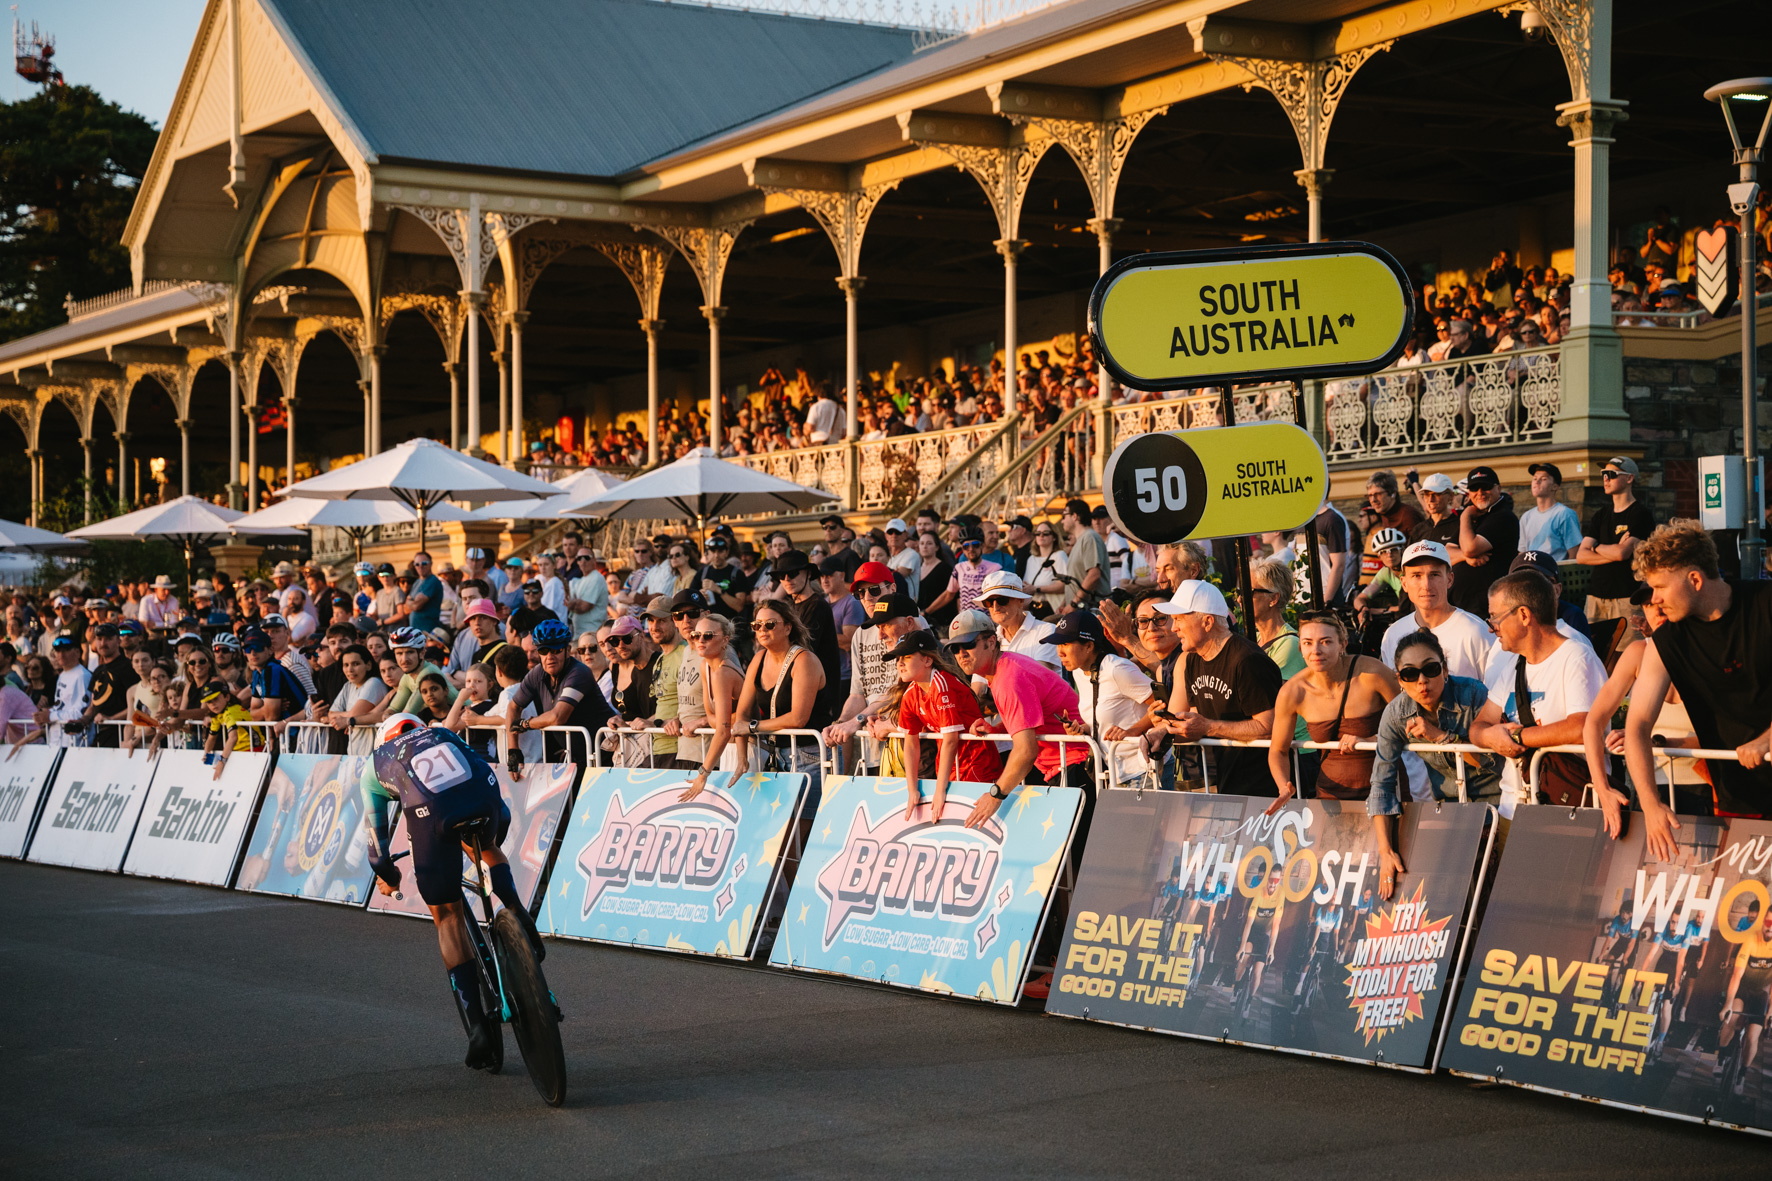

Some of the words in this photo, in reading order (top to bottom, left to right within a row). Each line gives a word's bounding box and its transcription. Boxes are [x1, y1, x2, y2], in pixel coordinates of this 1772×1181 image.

[1200, 279, 1300, 317] SOUTH
[1169, 314, 1339, 358] AUSTRALIA
[1134, 465, 1187, 513] 50
[1222, 476, 1304, 499] AUSTRALIA
[1236, 459, 1286, 479] SOUTH
[414, 749, 457, 783] 21
[51, 781, 136, 833] Santini
[148, 786, 242, 844] Santini
[596, 822, 735, 886] BARRY
[1179, 841, 1369, 906] WHOOSH
[838, 838, 999, 917] BARRY
[601, 896, 616, 911] LOW
[617, 897, 640, 914] SUGAR
[642, 900, 658, 916] LOW
[658, 902, 676, 918] CARB
[678, 904, 694, 920] LOW
[694, 906, 709, 922] CAL
[1393, 901, 1427, 932] TRY
[1631, 869, 1771, 944] WHO
[845, 925, 863, 942] LOW
[863, 928, 890, 946] SUGAR
[892, 931, 911, 950] LOW
[911, 934, 931, 952] CARB
[933, 937, 952, 956] LOW
[952, 940, 968, 958] CAL
[1073, 911, 1164, 949] SAVE
[1169, 922, 1203, 952] IT
[1352, 930, 1450, 967] MYWHOOSH
[1065, 944, 1127, 976] FOR
[1137, 953, 1195, 985] THE
[1349, 966, 1404, 998] TODAY
[1402, 963, 1438, 994] FOR
[1480, 949, 1610, 1000] SAVE
[1618, 968, 1669, 1007] IT
[1059, 974, 1116, 998] GOOD
[1119, 982, 1187, 1008] STUFF!
[1360, 997, 1409, 1028] FREE!
[1468, 987, 1558, 1031] FOR
[1571, 1003, 1655, 1047] THE
[1460, 1023, 1542, 1056] GOOD
[1547, 1038, 1647, 1075] STUFF!
